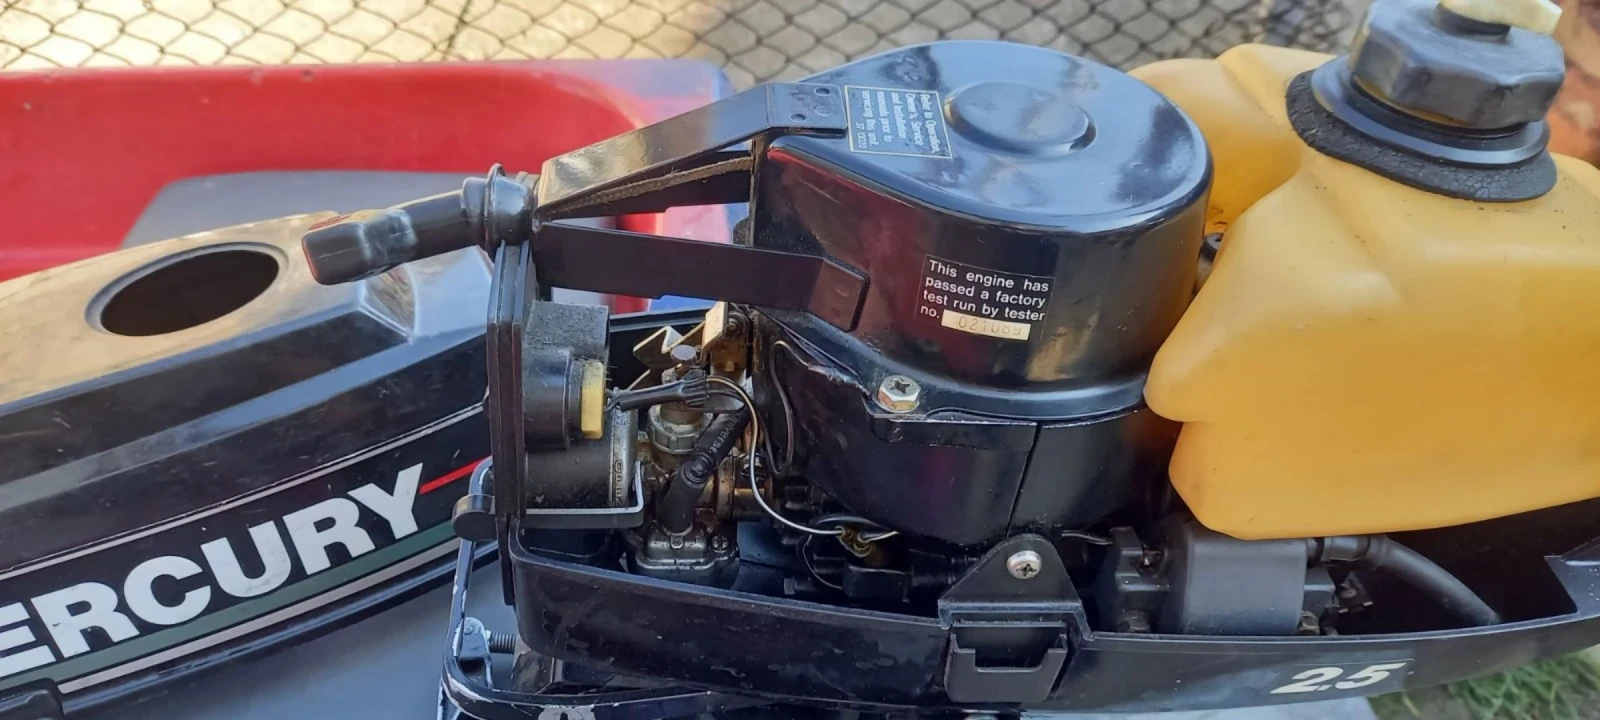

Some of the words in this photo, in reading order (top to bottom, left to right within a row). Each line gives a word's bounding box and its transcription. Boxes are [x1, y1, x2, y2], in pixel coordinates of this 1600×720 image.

[862, 90, 874, 118] servicing
[877, 91, 890, 117] manuals
[891, 92, 902, 105] and
[920, 94, 931, 110] Refer
[866, 119, 877, 131] this
[879, 118, 892, 133] prior
[923, 111, 934, 119] to
[867, 132, 880, 147] unit.
[911, 121, 924, 146] Service
[929, 259, 957, 278] This
[966, 272, 1015, 289] engine
[1023, 279, 1049, 292] has
[923, 289, 948, 306] test
[953, 300, 976, 312] run
[982, 303, 999, 318] by
[1004, 308, 1045, 321] tester
[925, 276, 975, 297] passed
[980, 290, 989, 300] a
[995, 290, 1046, 309] factory
[920, 305, 940, 319] no.
[0, 463, 423, 677] ERCURY
[1269, 662, 1407, 695] 2.5
